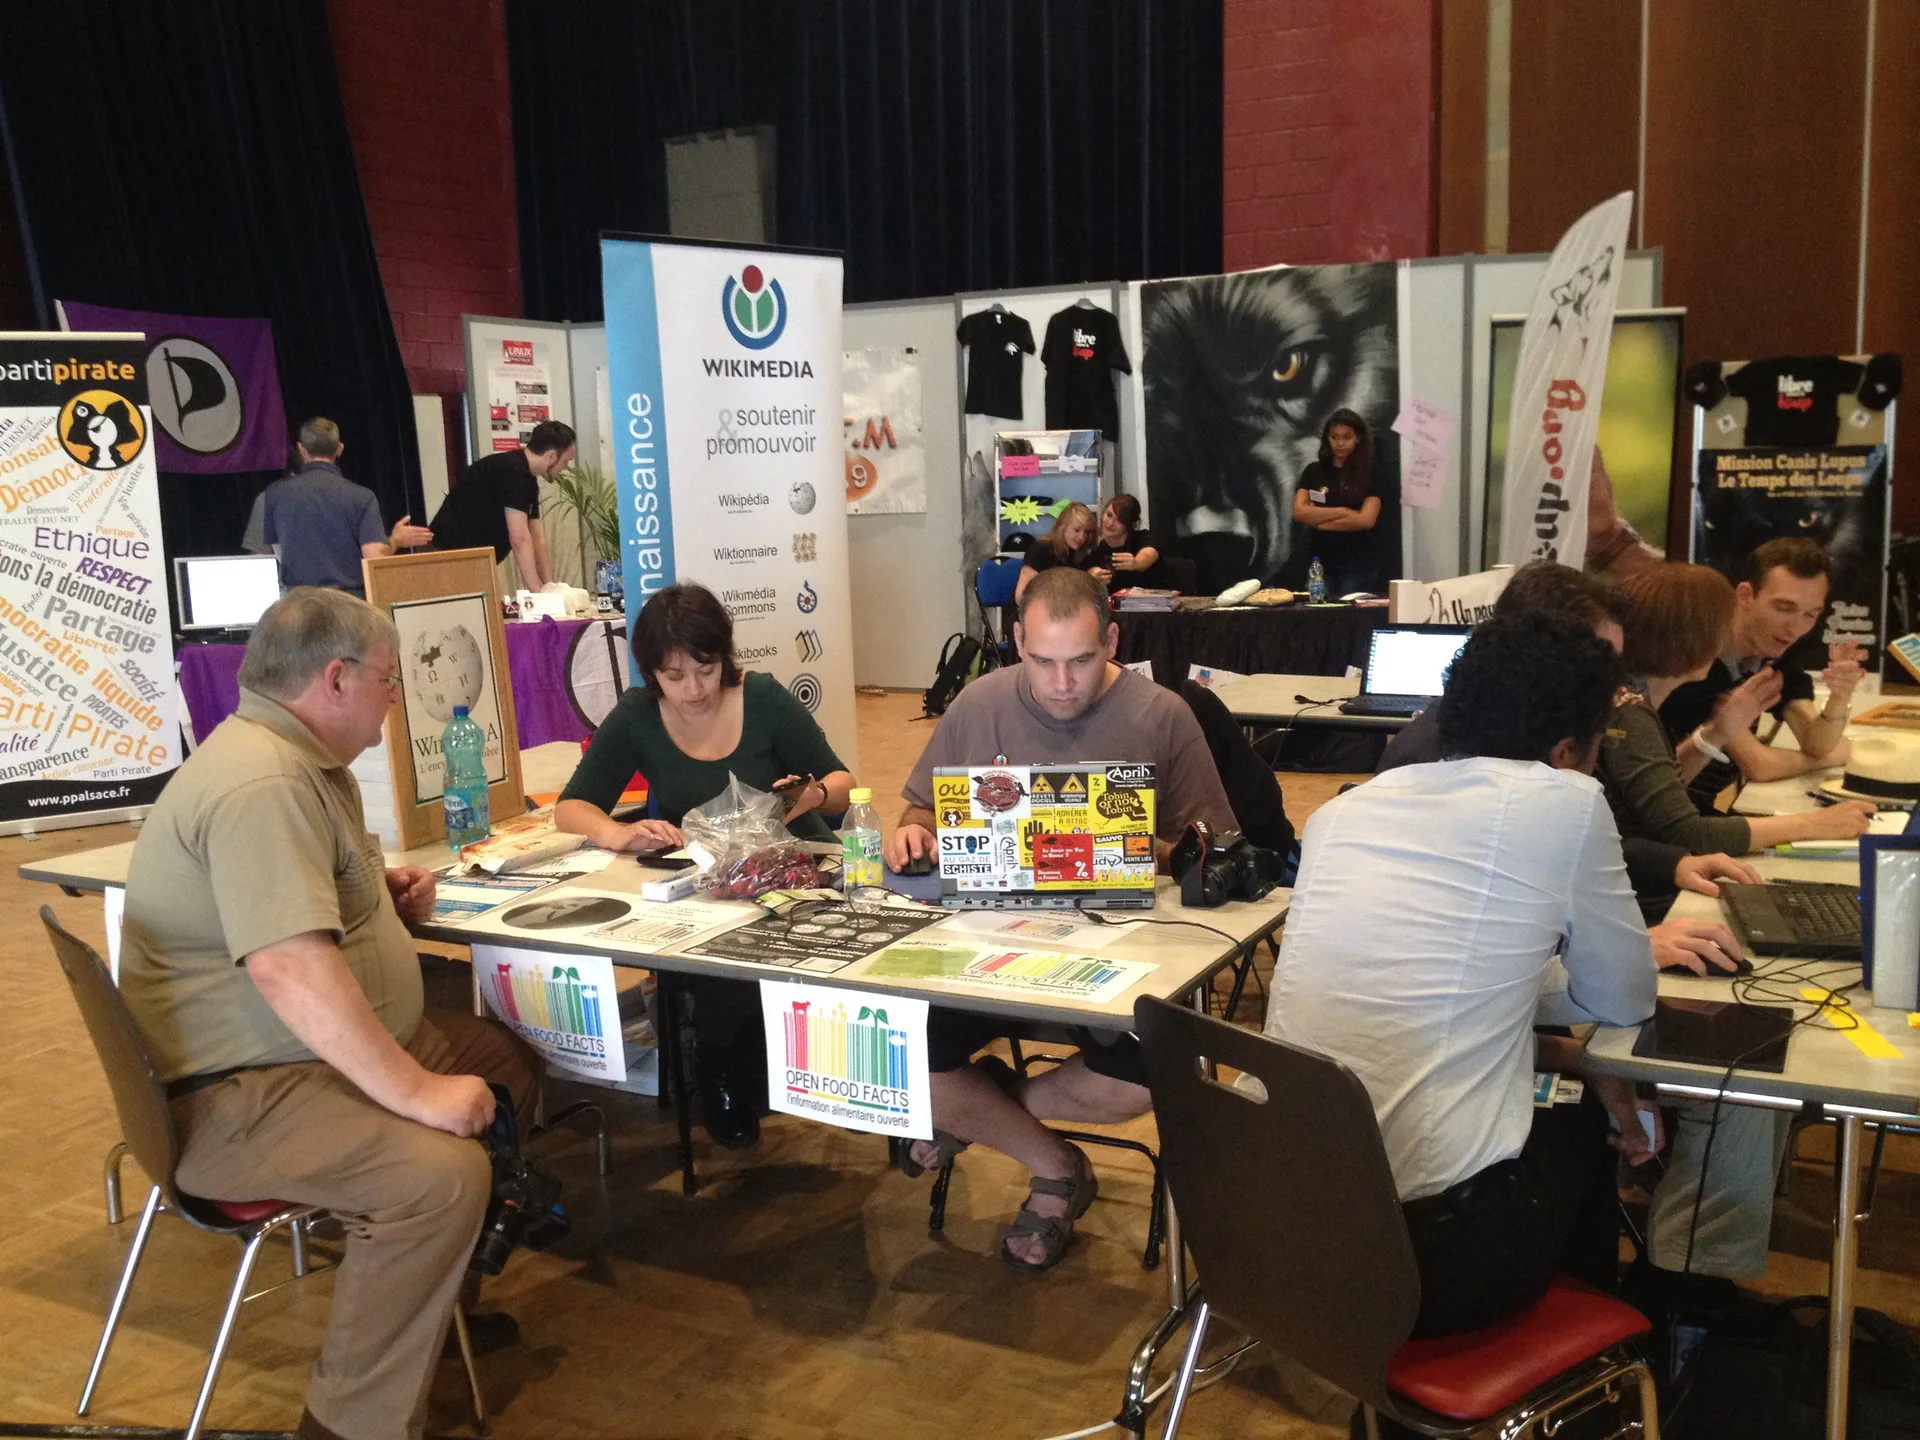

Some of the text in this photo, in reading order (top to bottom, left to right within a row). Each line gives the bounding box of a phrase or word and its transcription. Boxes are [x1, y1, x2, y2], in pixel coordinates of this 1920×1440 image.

[702, 359, 815, 379] WIKIMEDIA
[737, 405, 817, 426] soutenir
[707, 432, 817, 460] promouvoir
[1716, 452, 1867, 472] Mission Canis Lupus
[1718, 473, 1736, 488] Le
[1738, 471, 1787, 491] Temps
[1789, 471, 1815, 487] des
[627, 392, 663, 607] naissance
[718, 493, 770, 508] Wikipédia
[34, 526, 149, 560] Ethique
[713, 545, 778, 562] Wiktionnaire
[30, 551, 68, 570] ouverte
[75, 556, 152, 596] RESPECT
[34, 562, 54, 589] la
[56, 572, 157, 625] démocratie
[722, 587, 776, 602] Wikimédia
[43, 594, 156, 654] Partage
[62, 629, 118, 655] Liberté
[119, 658, 167, 703] SOCIÉTÉ
[91, 667, 163, 732] liquide
[82, 693, 130, 730] PIRATES
[66, 712, 168, 767] Pirate
[93, 765, 153, 779] Parti Pirate
[1110, 765, 1146, 781] April
[28, 786, 131, 808] www.ppalsace.fr
[1099, 796, 1135, 808] or not
[1103, 791, 1130, 801] Tobin
[1105, 805, 1133, 815] Tobin
[944, 864, 991, 875] SCHISTE
[961, 969, 1103, 991] OPEN FOOD FACTS
[534, 1027, 564, 1046] FOOD
[566, 1034, 605, 1053] FACTS
[786, 1070, 909, 1108] OPEN FOOD FACTS
[787, 1094, 910, 1128] l'information alimentaire ouverte
